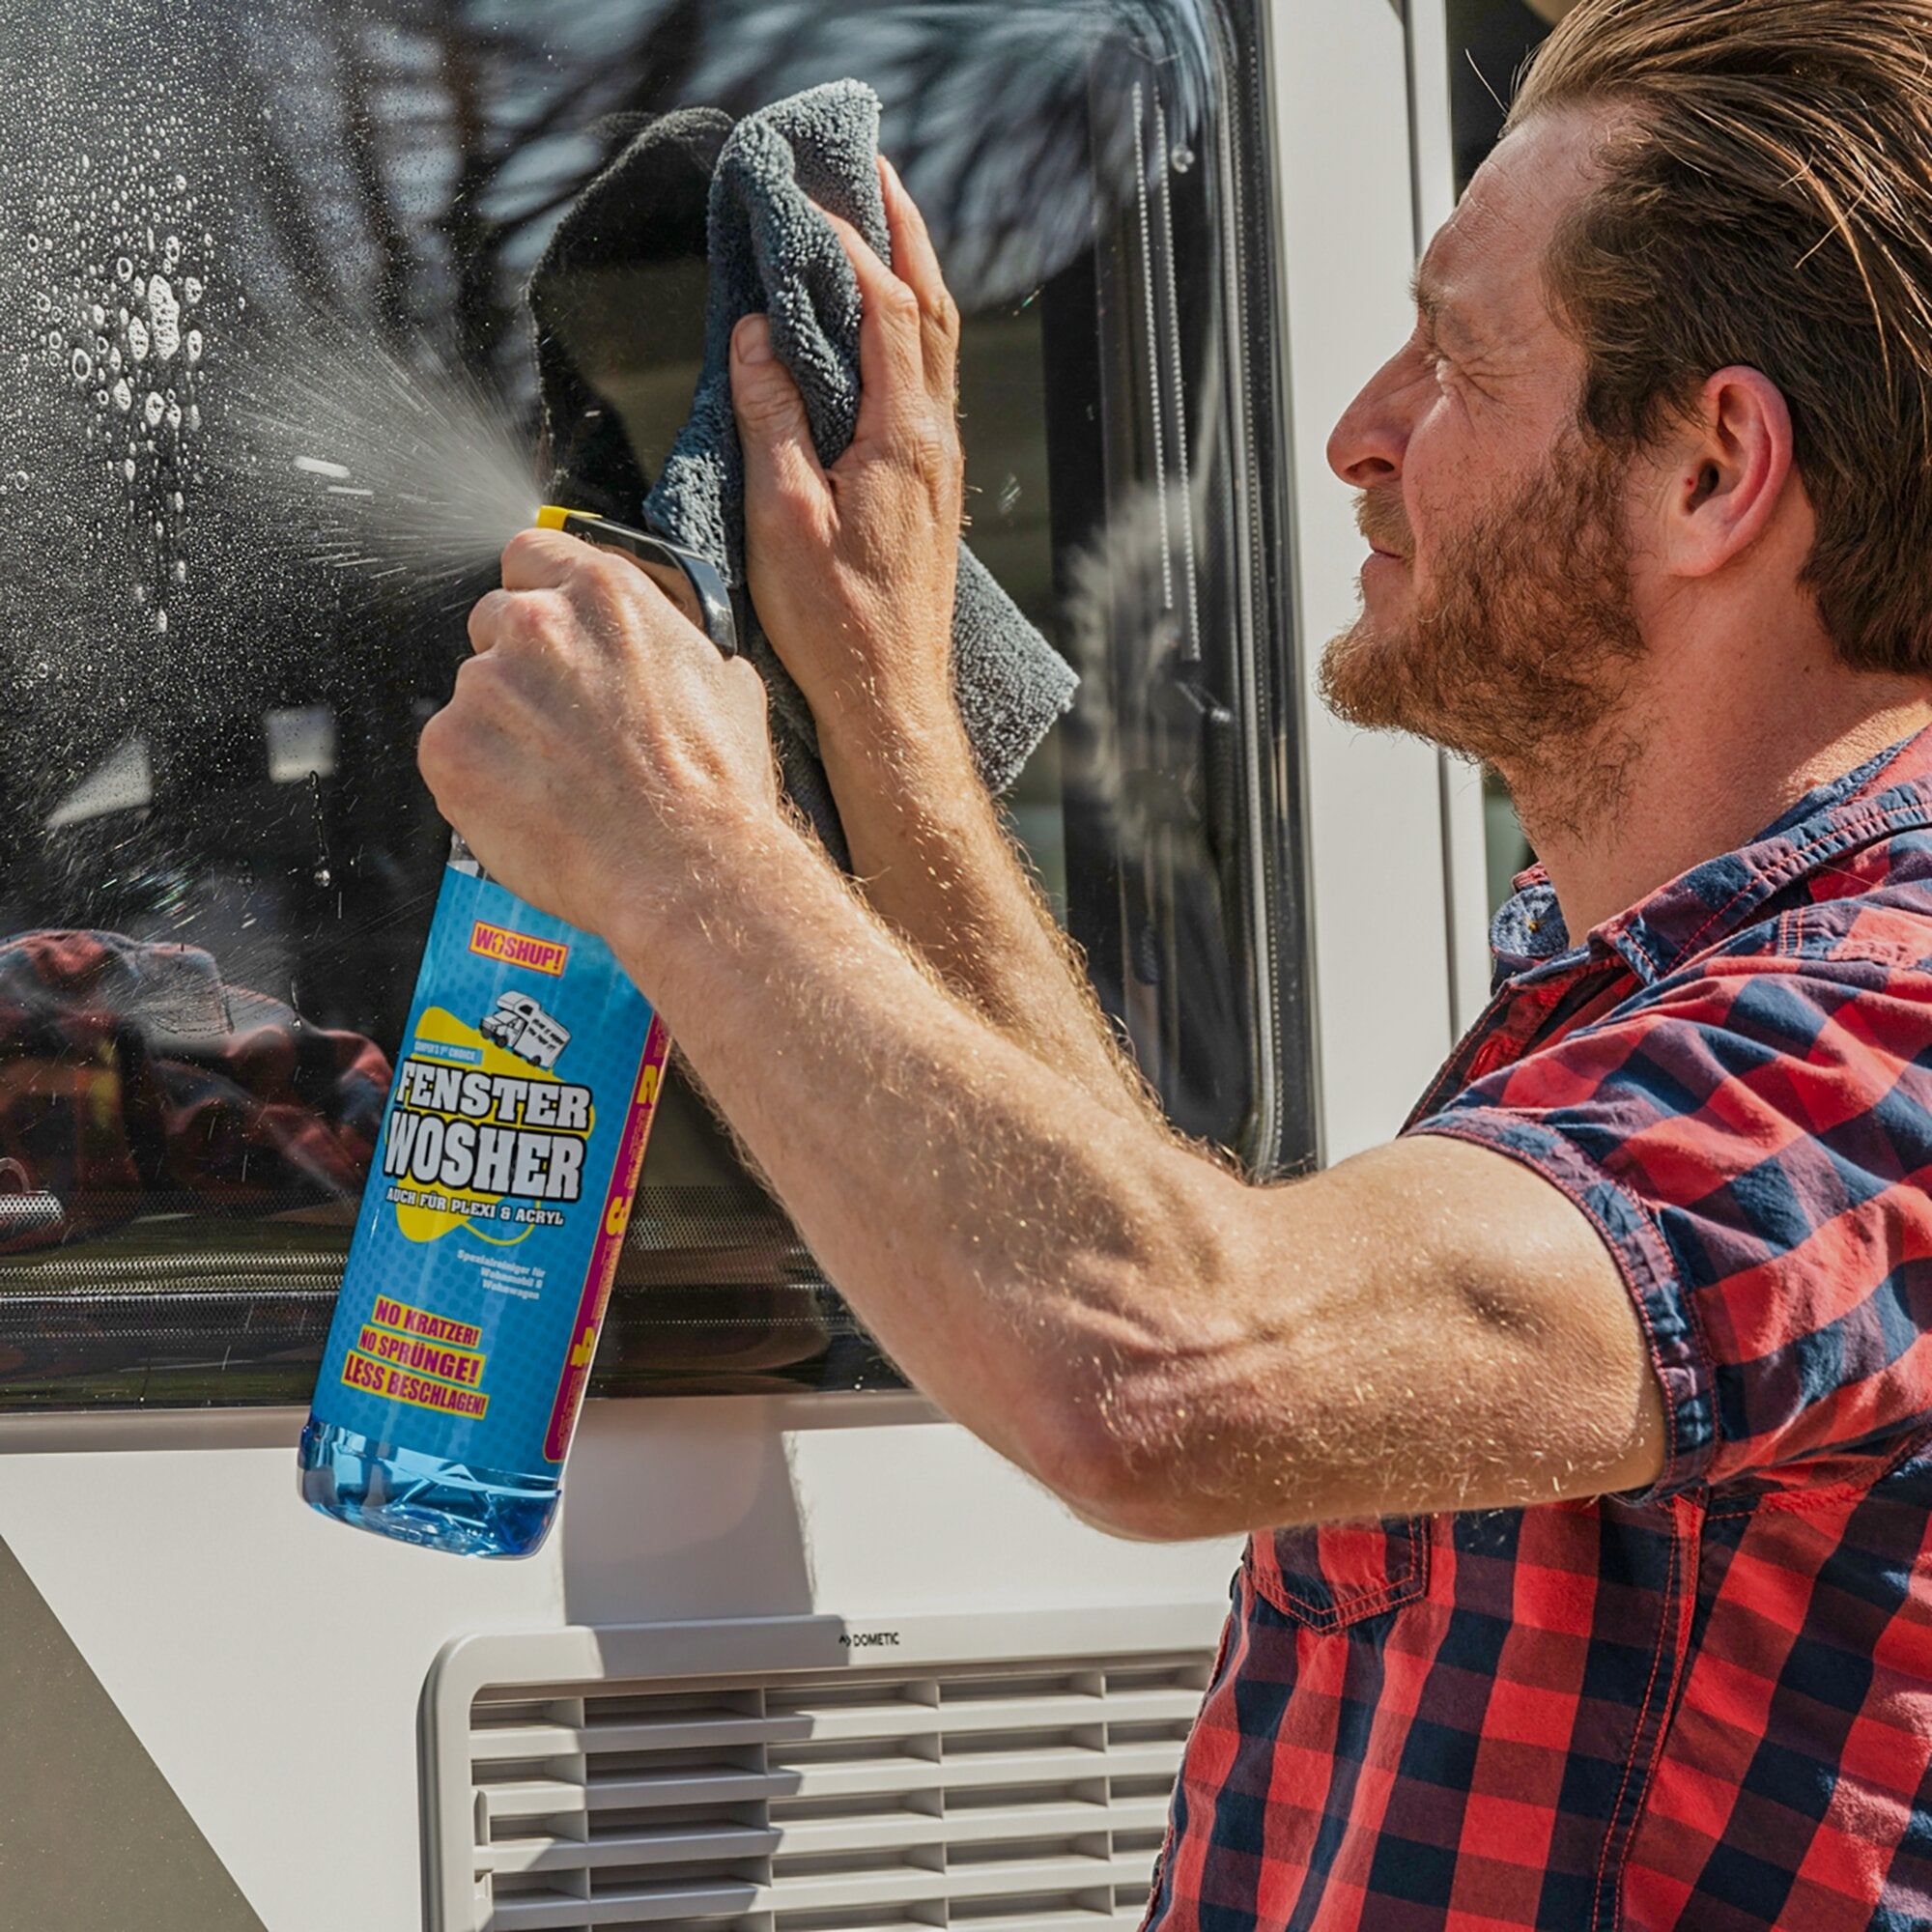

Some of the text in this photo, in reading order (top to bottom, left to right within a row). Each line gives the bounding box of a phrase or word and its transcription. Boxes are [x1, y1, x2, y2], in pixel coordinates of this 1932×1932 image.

[474, 925, 563, 970] WOSHUP!
[394, 1060, 592, 1130] FENSTER
[384, 1110, 585, 1201] WOSHER
[386, 1187, 565, 1225] AUCH FÜR PLEXI & ACRYL
[375, 1298, 480, 1347] NO KRATZER!
[359, 1329, 481, 1383] NO SPRÜNGE!
[344, 1354, 487, 1416] LESS BESCHLAGEN!
[853, 1632, 900, 1647] DOMETIC
